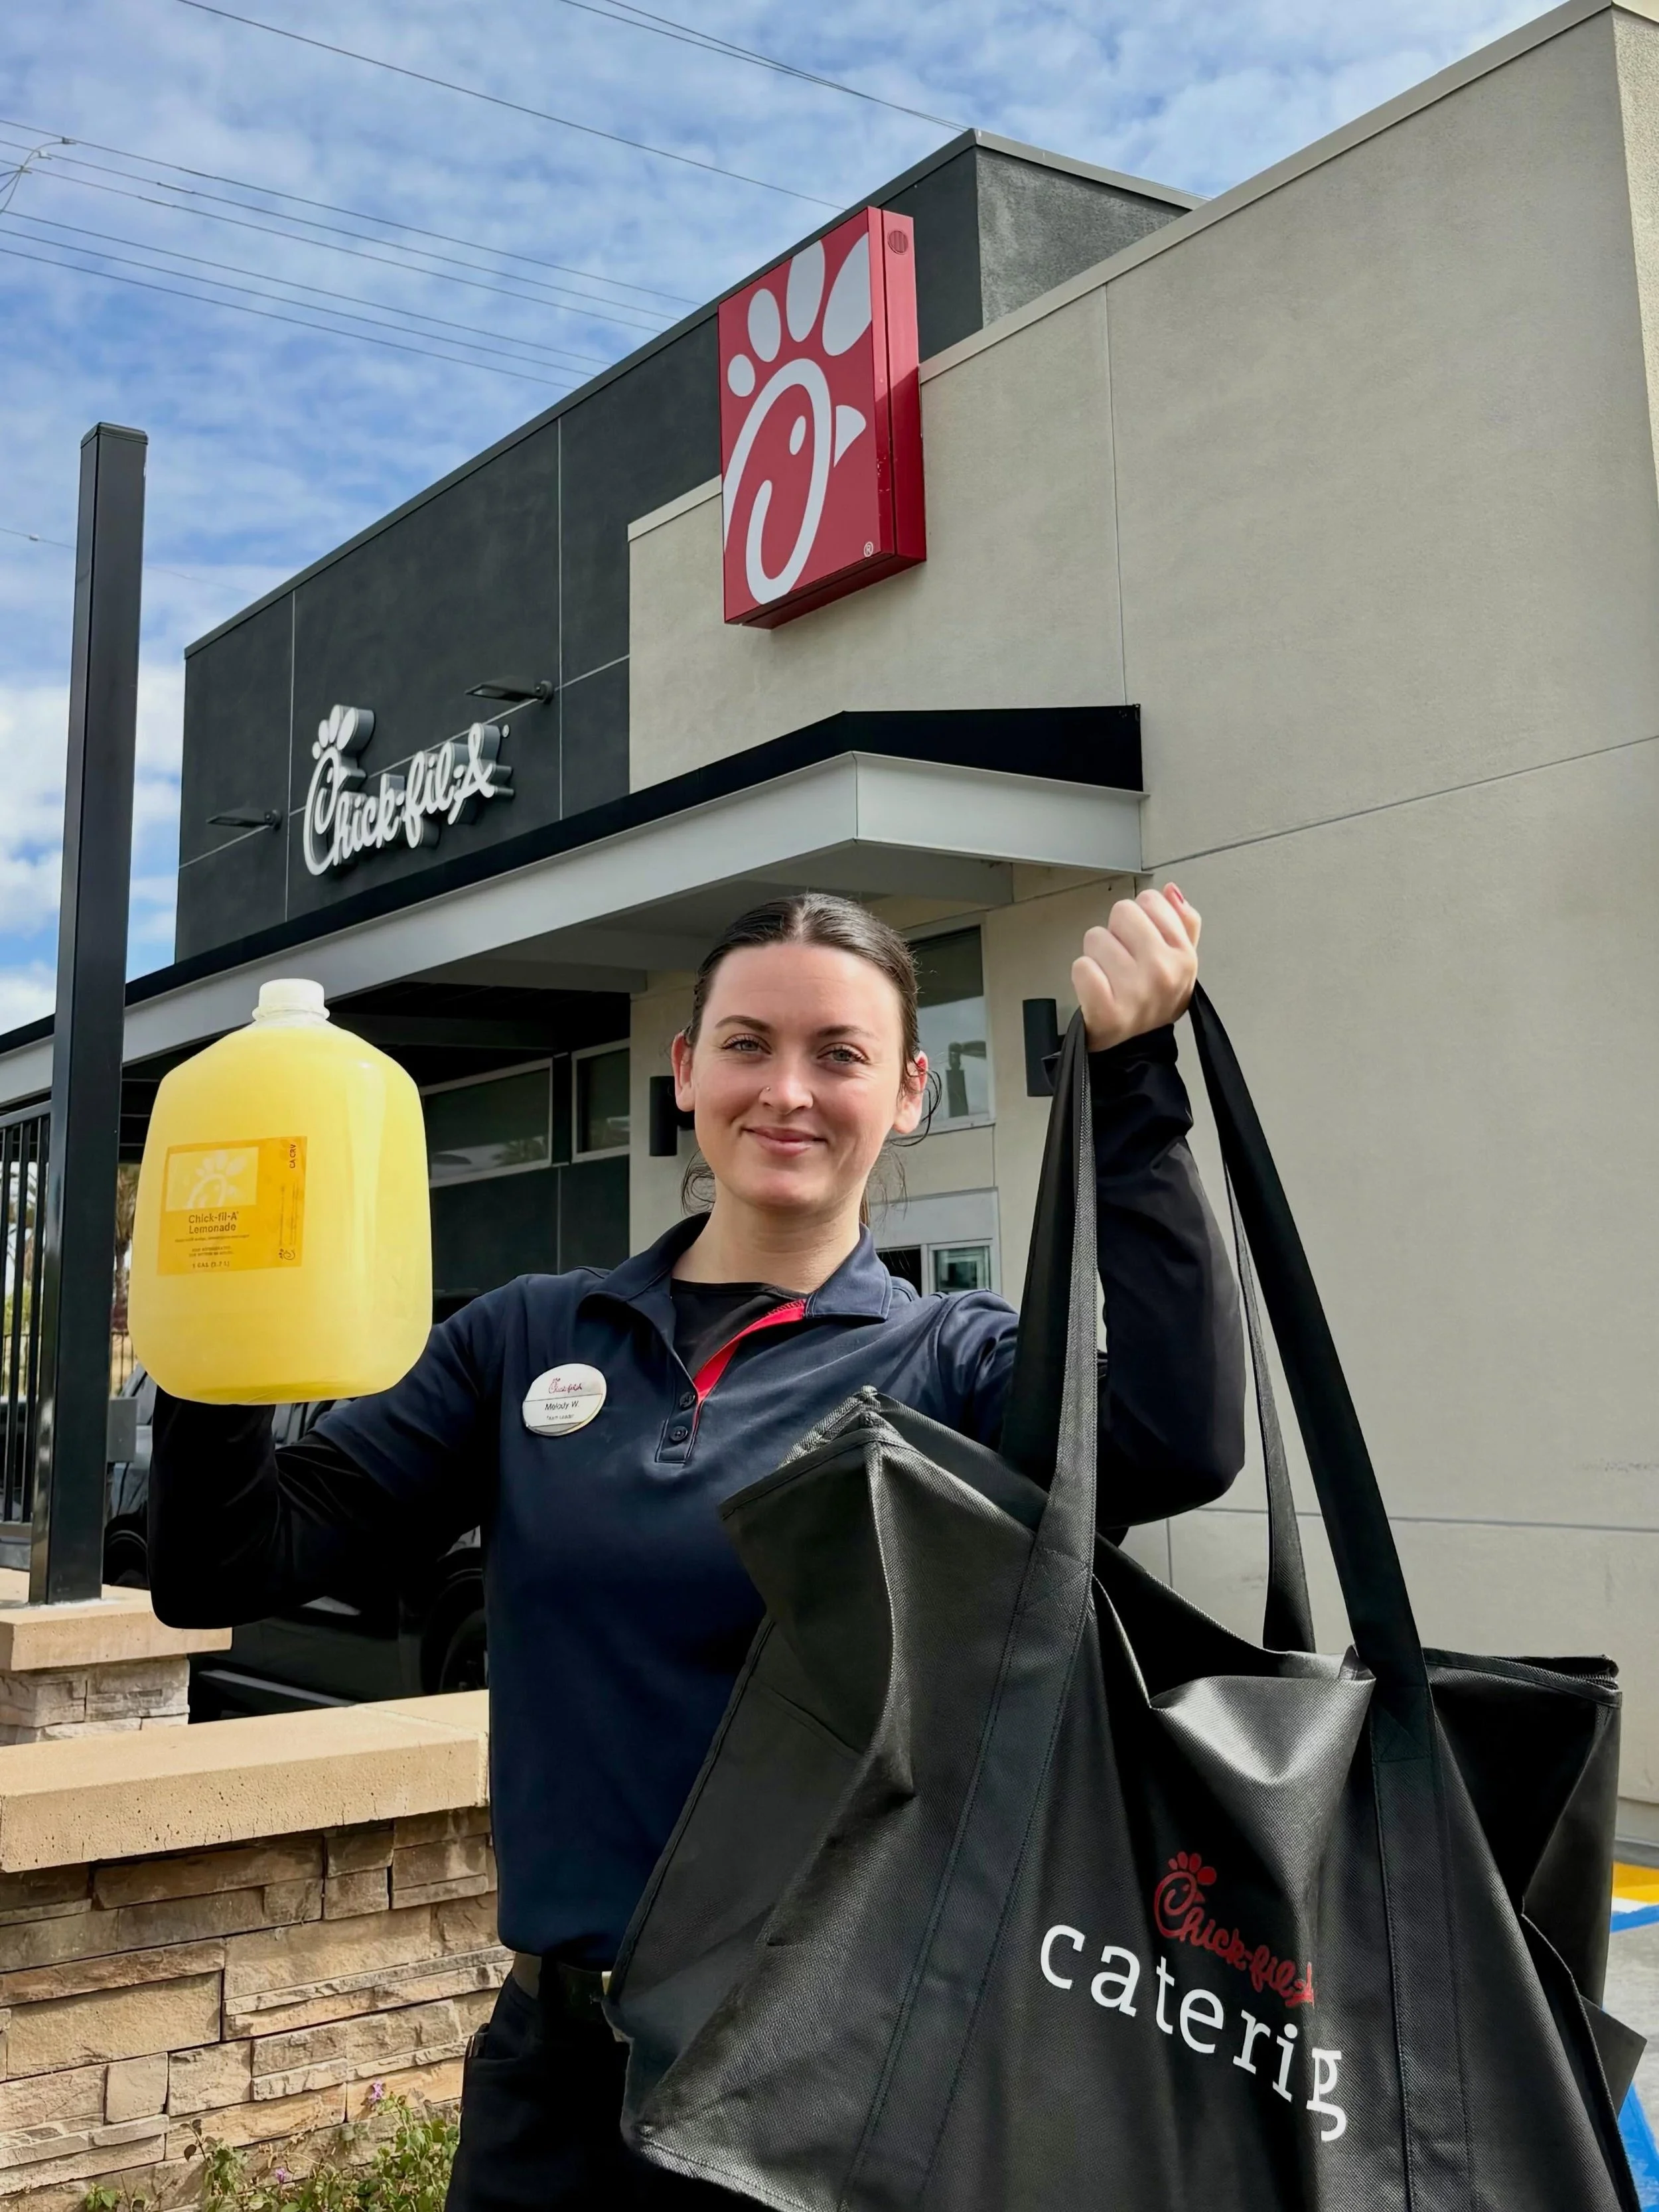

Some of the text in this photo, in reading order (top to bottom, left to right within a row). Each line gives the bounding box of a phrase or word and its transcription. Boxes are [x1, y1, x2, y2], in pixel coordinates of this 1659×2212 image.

[289, 1159, 296, 1169] CA
[188, 1212, 238, 1224] Chick-fil-A
[188, 1222, 236, 1234] Lemonade
